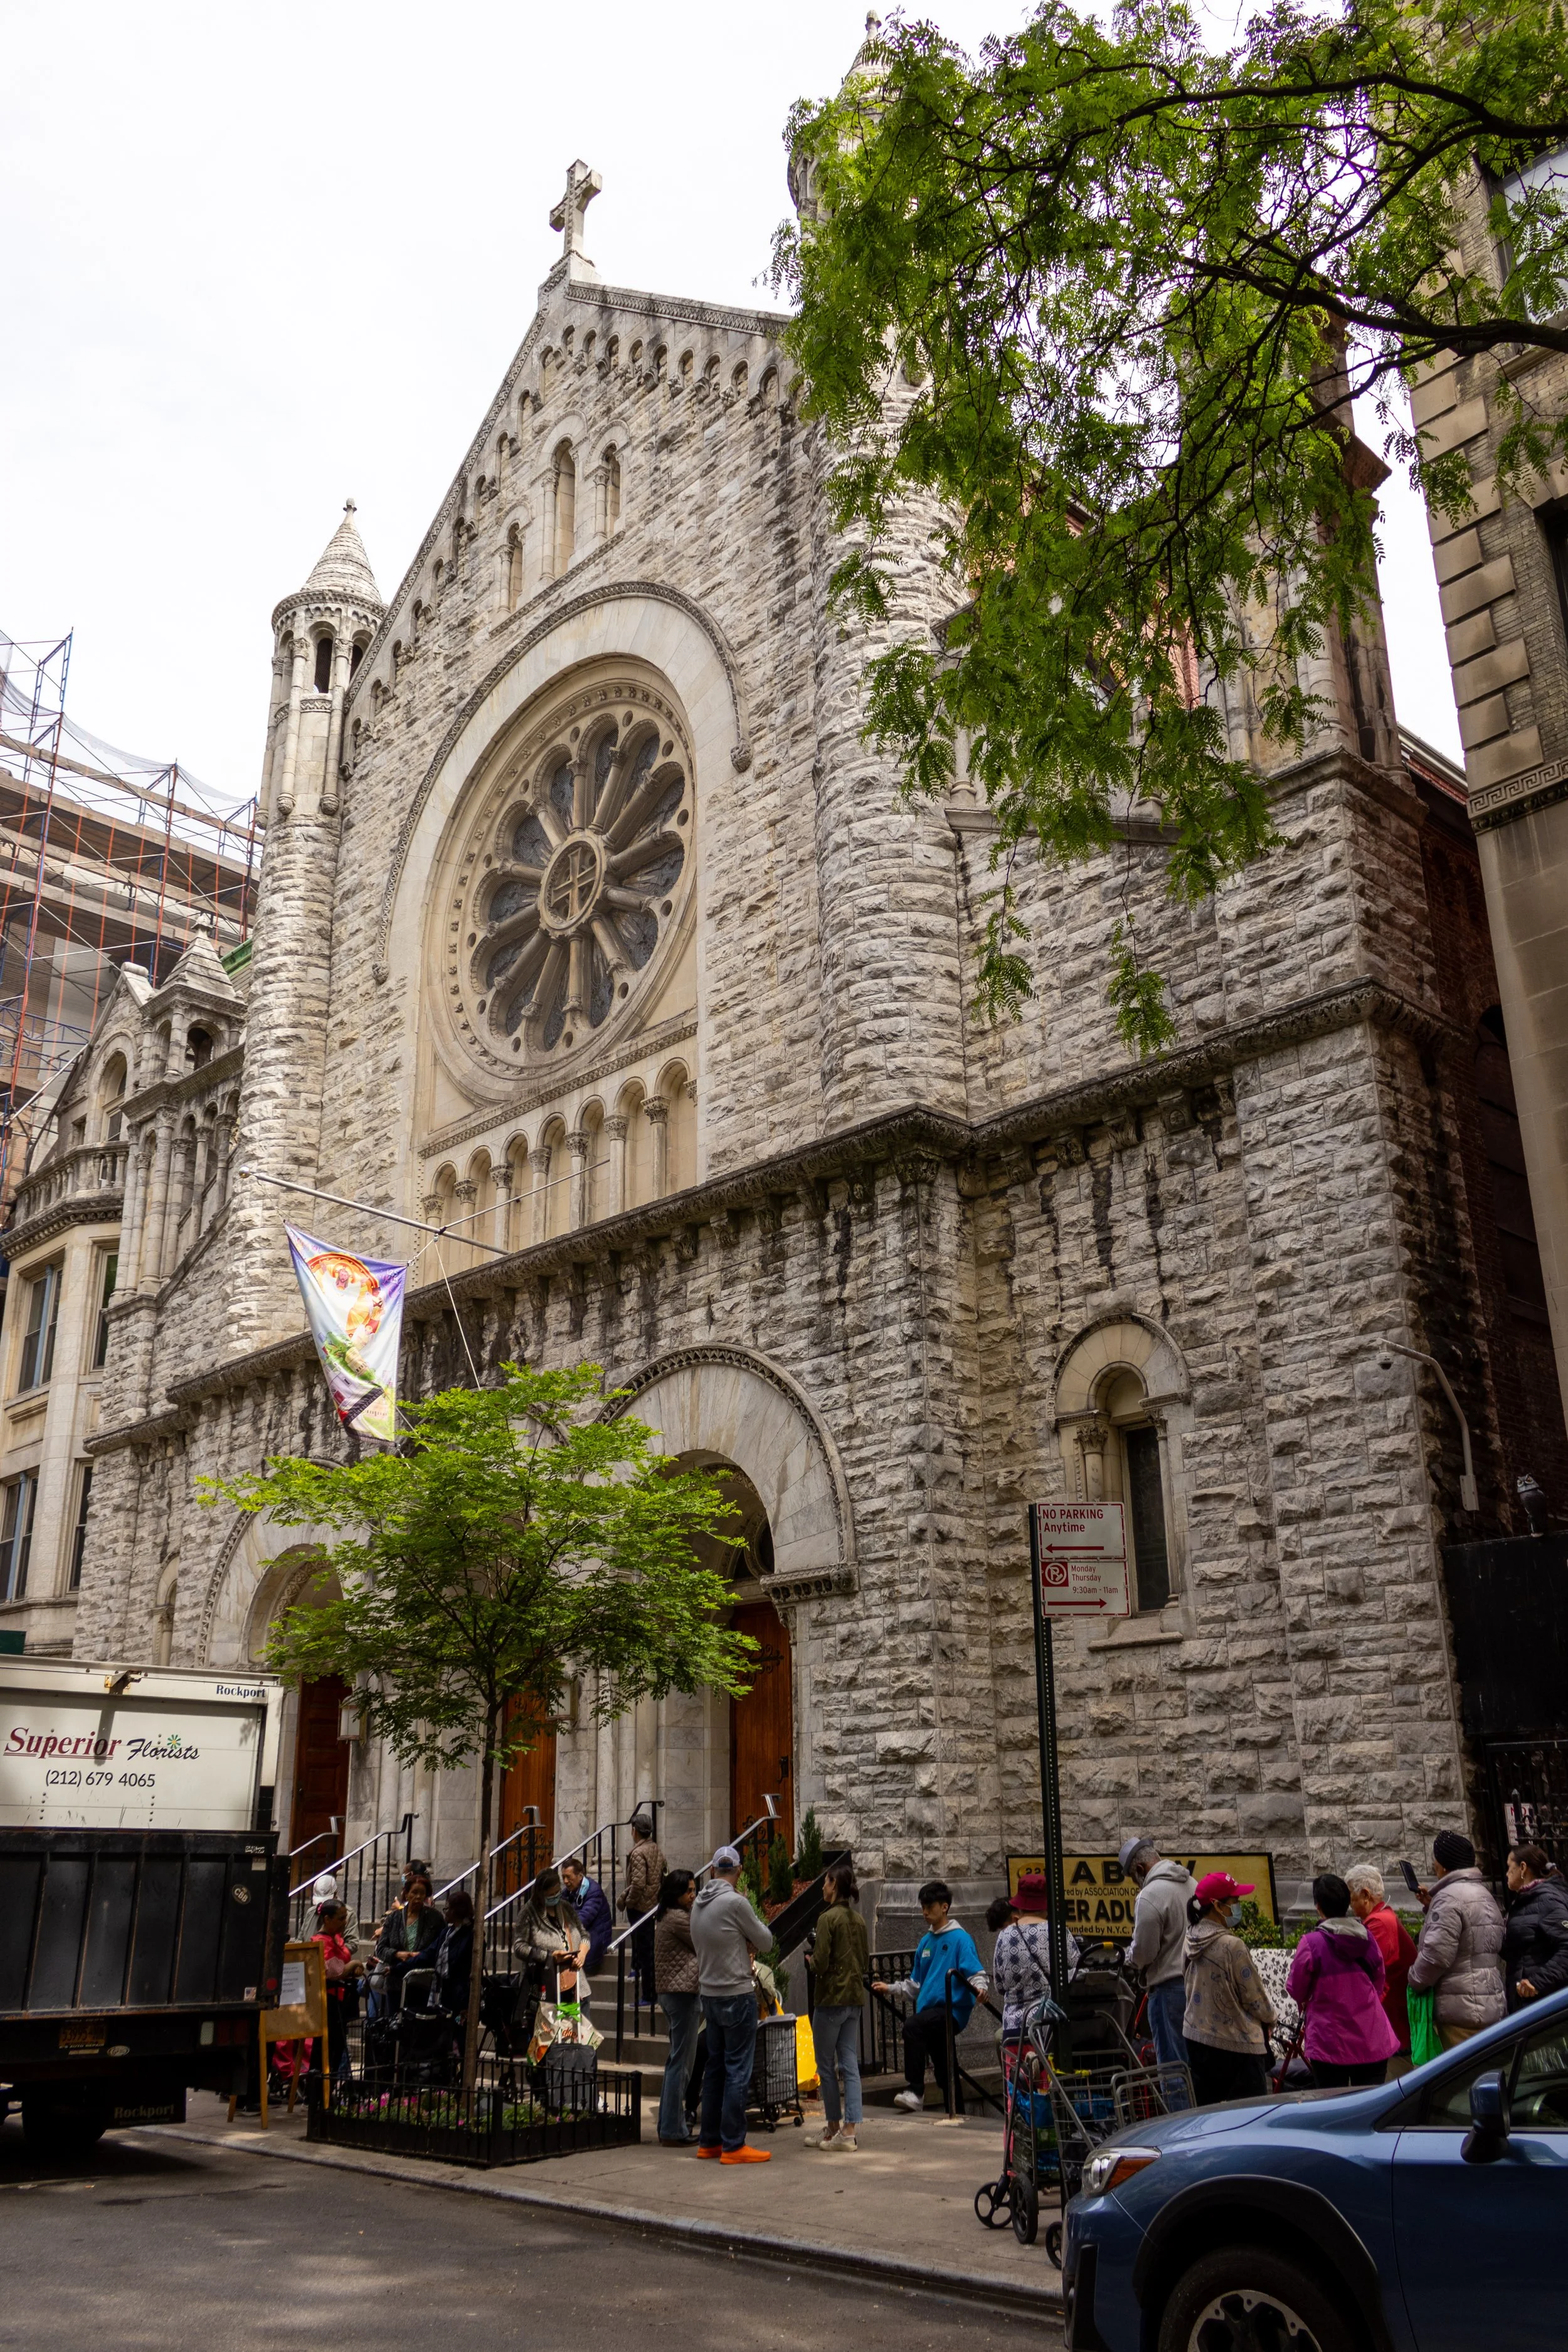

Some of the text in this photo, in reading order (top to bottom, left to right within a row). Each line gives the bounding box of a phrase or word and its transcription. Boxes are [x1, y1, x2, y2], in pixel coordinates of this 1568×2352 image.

[1042, 1509, 1104, 1519] NO PARKING
[1044, 1522, 1085, 1534] Anytime
[1071, 1565, 1096, 1575] Monday
[1072, 1574, 1101, 1582] Thursday
[216, 1685, 266, 1698] Rockport
[4, 1727, 200, 1761] Superior Florists
[46, 1769, 156, 1788] (212) 679 4065
[1076, 1888, 1083, 1897] by
[1084, 1887, 1130, 1896] ASSOCIATION
[1130, 1887, 1140, 1896] OF
[1065, 1899, 1135, 1924] ER ADU
[1067, 1925, 1093, 1934] unded
[1095, 1926, 1104, 1935] by
[1106, 1926, 1130, 1934] N.Y.C.
[114, 2103, 175, 2119] Rockport
